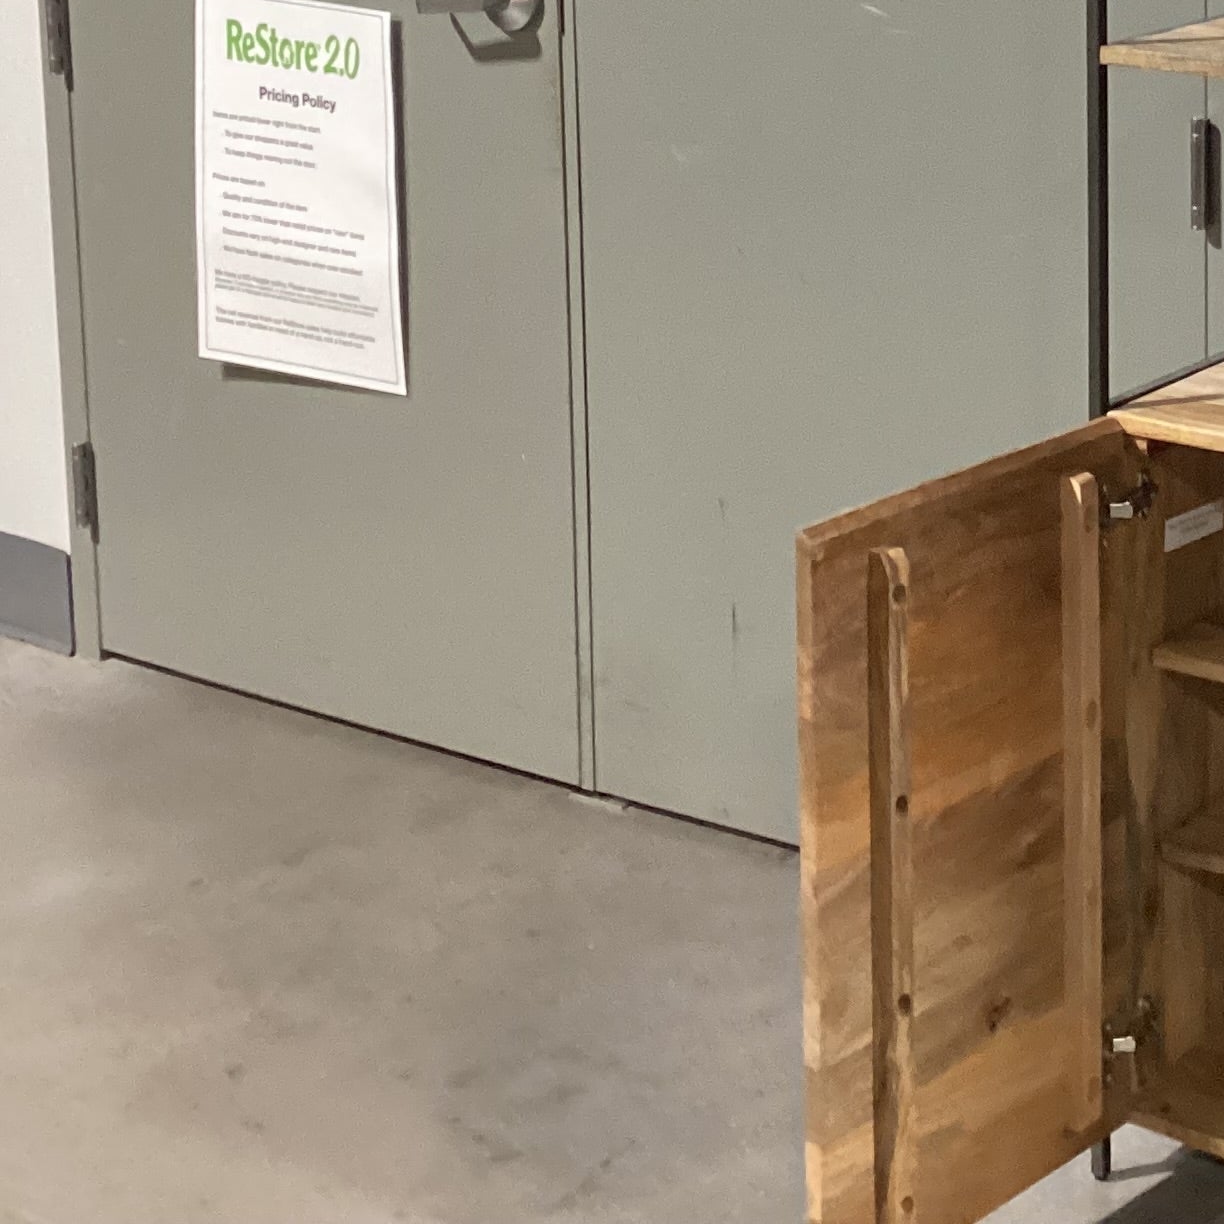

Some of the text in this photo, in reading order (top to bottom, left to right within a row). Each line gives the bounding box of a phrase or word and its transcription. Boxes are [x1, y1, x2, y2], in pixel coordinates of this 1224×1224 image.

[324, 34, 360, 80] 2.0
[259, 86, 336, 113] Pricing Policy
